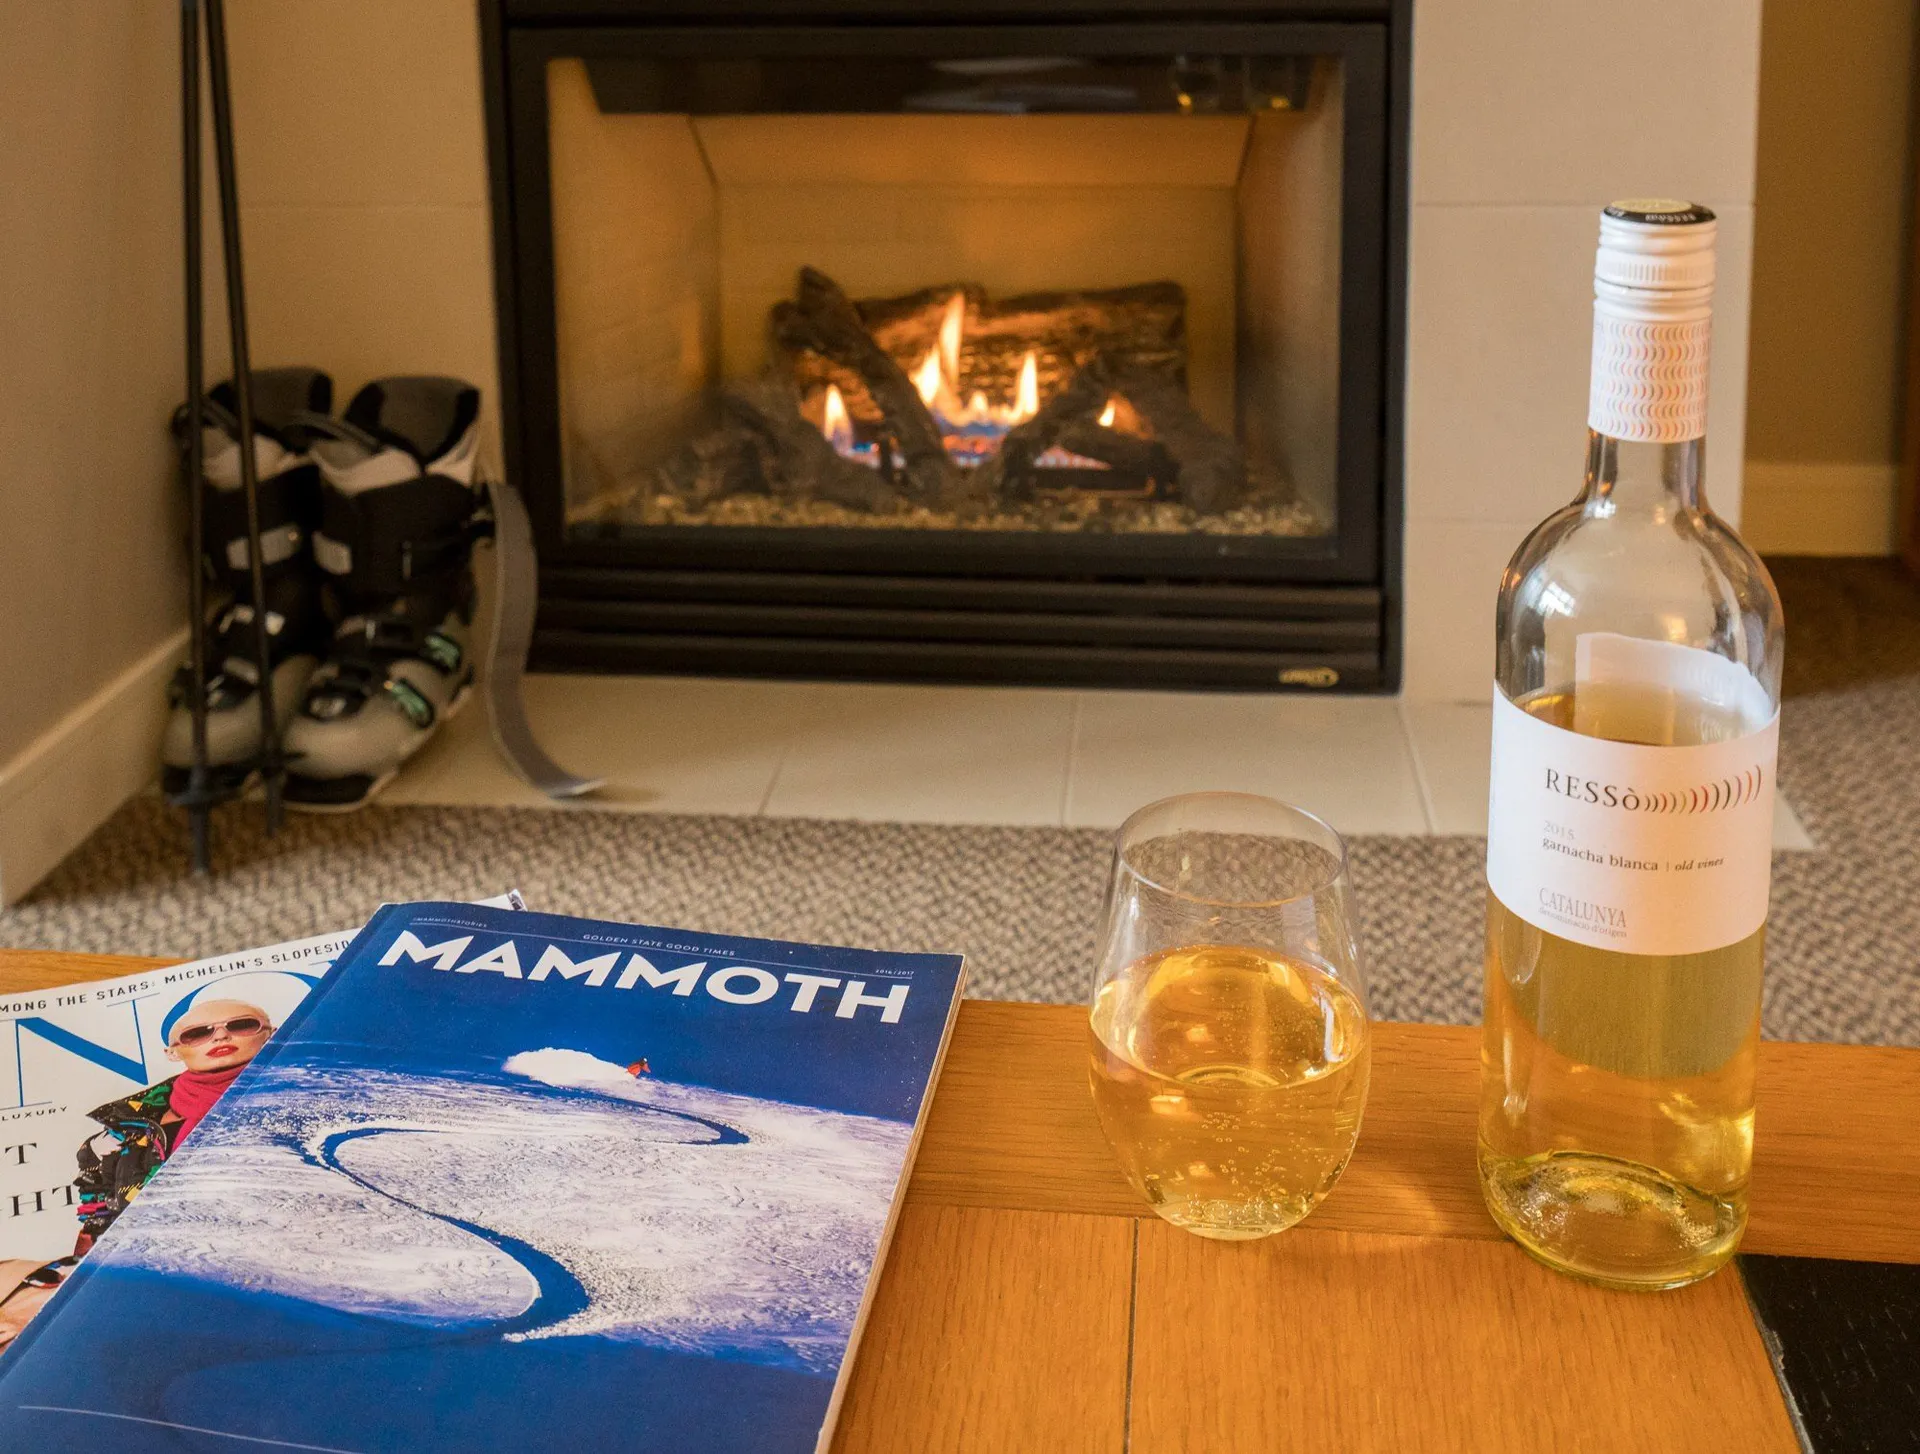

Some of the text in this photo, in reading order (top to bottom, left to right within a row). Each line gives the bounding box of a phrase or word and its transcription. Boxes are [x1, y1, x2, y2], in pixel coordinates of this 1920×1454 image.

[1543, 820, 1576, 841] 2015
[1542, 837, 1725, 872] garnacha blanca old vines
[1539, 887, 1627, 928] CATALUNYA
[582, 933, 736, 957] GOLDEN STATE GOOD TIMES
[55, 992, 88, 1008] THE
[164, 956, 264, 985] MICHELIN'S
[378, 929, 911, 1024] MAMMOTH
[1, 1106, 68, 1121] LUXURY
[0, 1184, 78, 1219] HT
